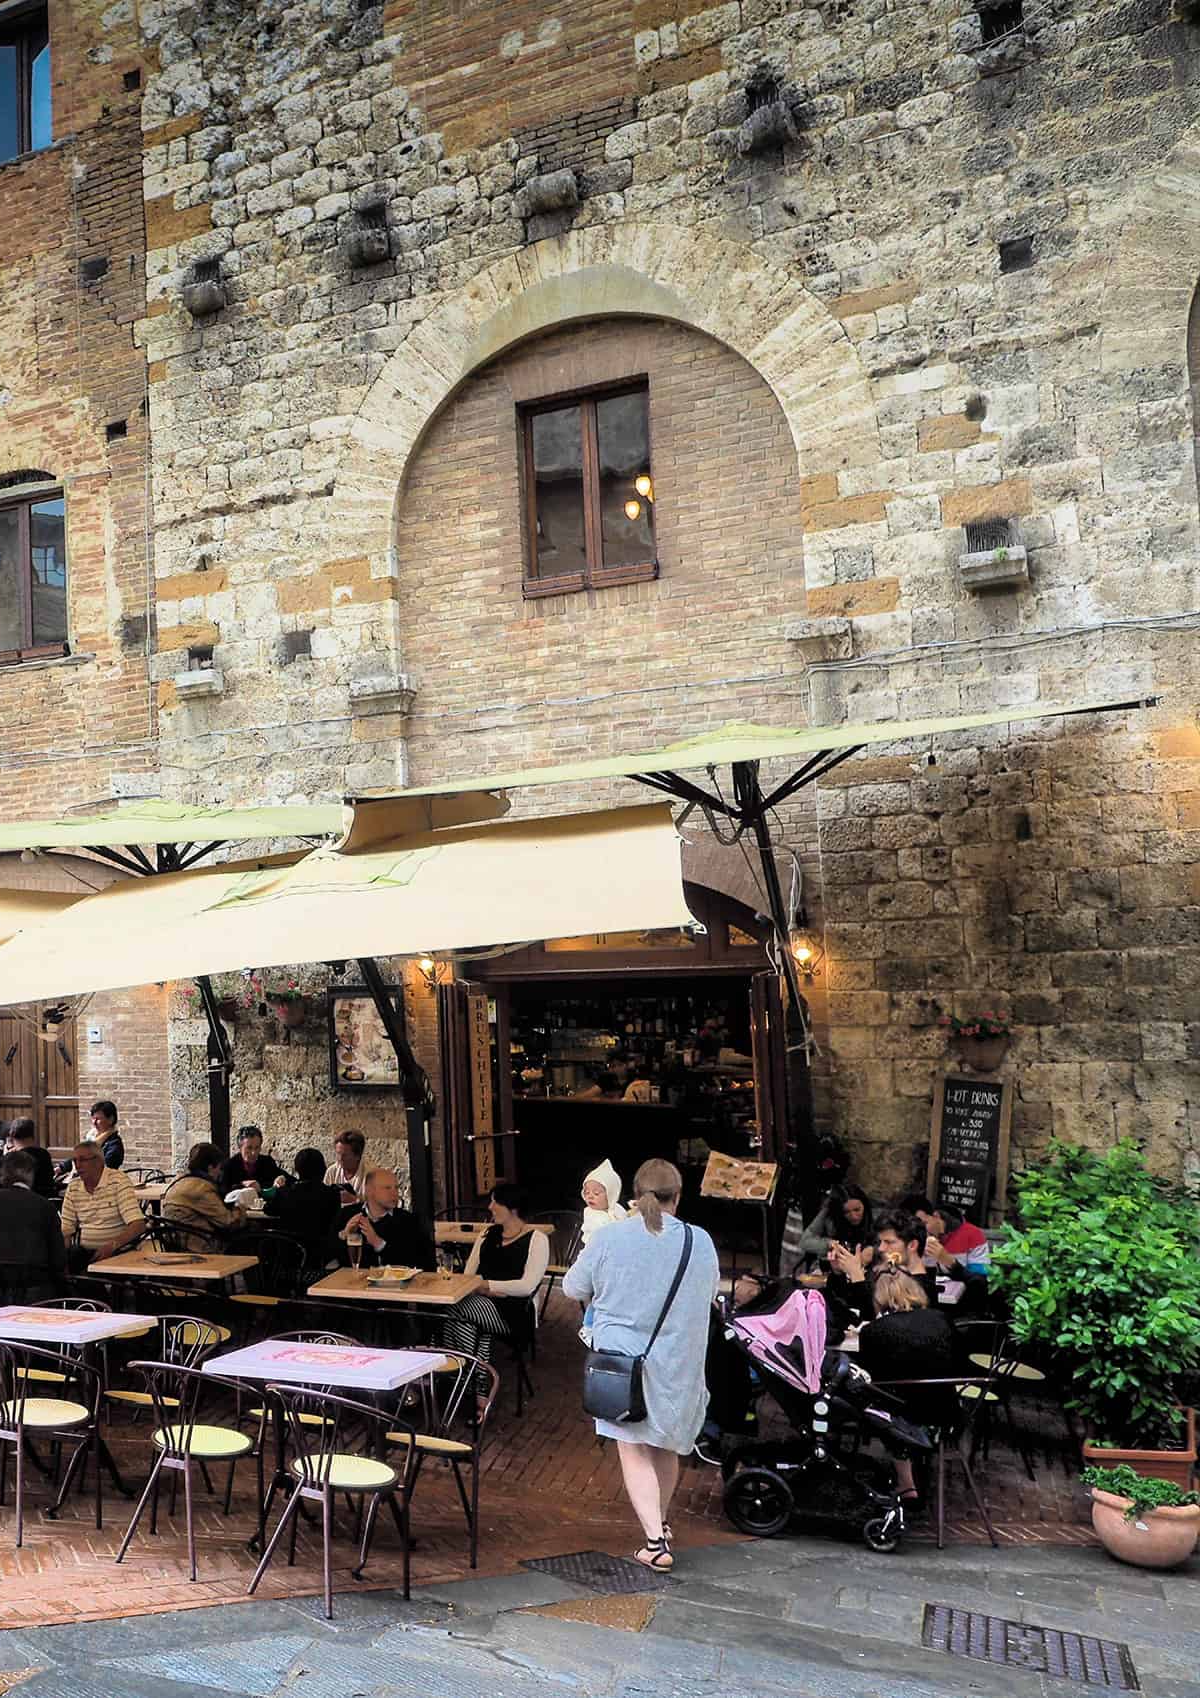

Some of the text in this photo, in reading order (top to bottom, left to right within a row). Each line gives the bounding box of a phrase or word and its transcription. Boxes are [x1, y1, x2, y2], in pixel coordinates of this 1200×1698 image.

[475, 1000, 489, 1120] BRUSCHETTE
[947, 1089, 999, 1106] HOT DRINKS
